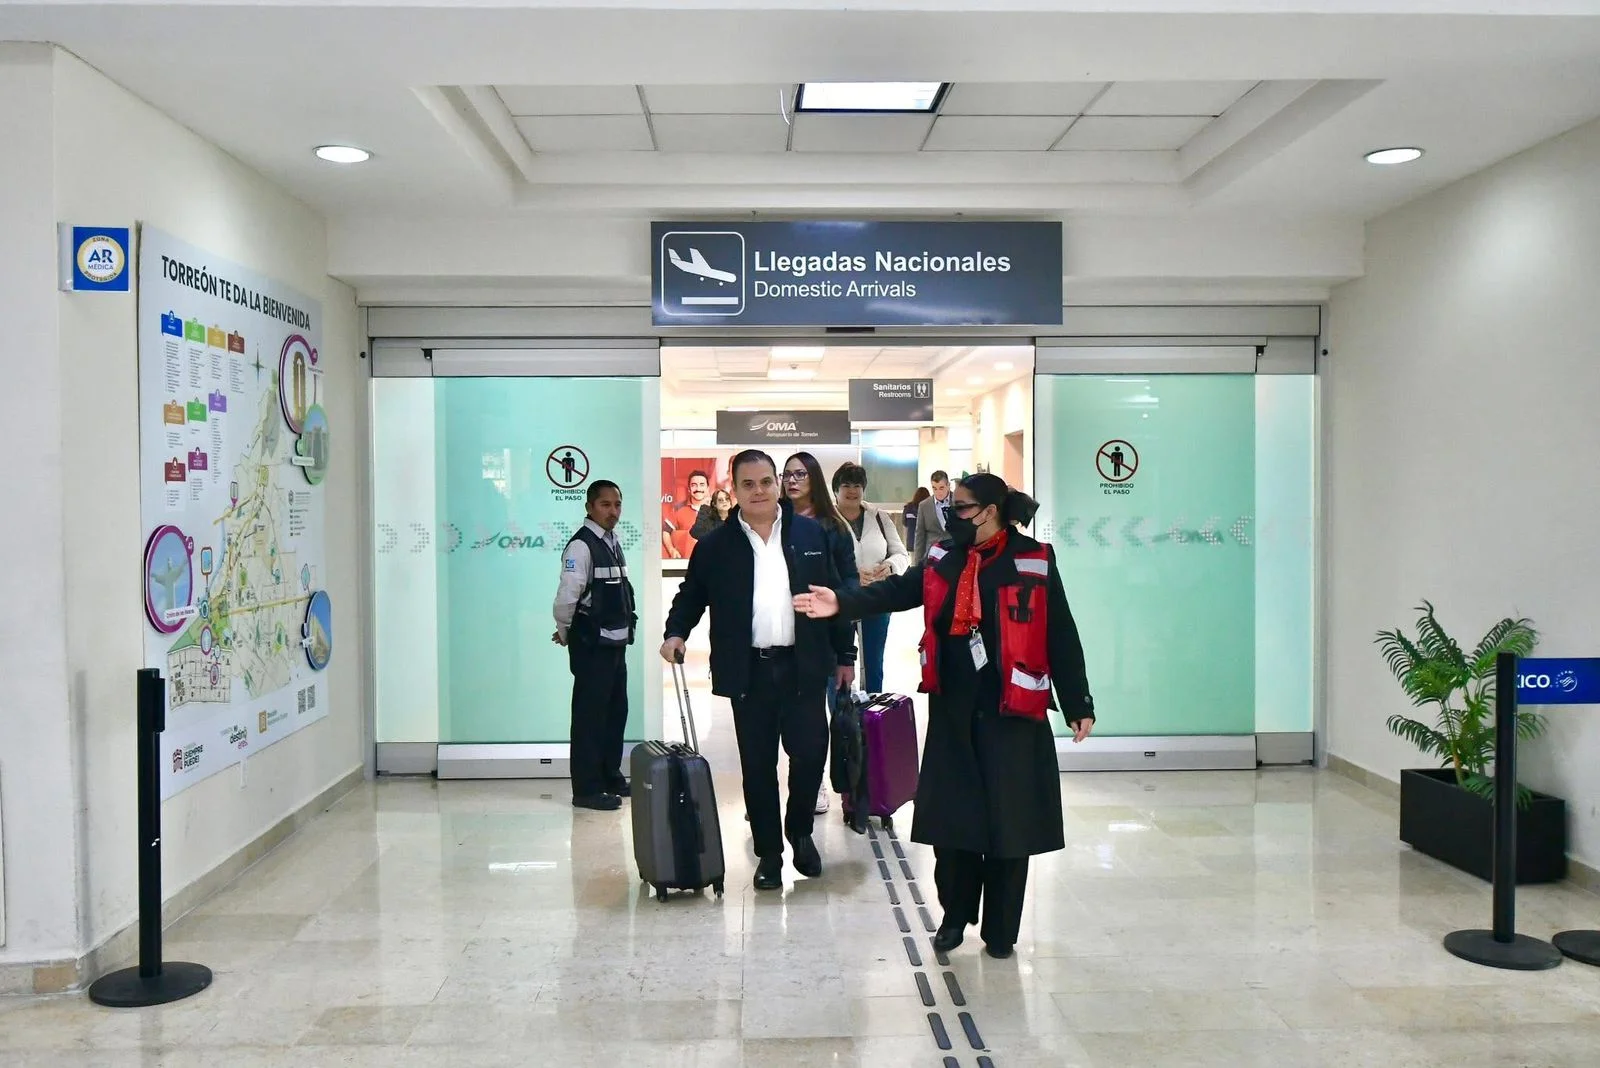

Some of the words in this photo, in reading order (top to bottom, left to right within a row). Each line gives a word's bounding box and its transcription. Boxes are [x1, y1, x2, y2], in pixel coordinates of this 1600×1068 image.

[88, 249, 113, 263] AR
[754, 251, 866, 277] Llegadas
[875, 251, 1011, 272] Nacionales
[161, 255, 217, 297] TORREÓN
[219, 278, 231, 302] TE
[233, 283, 248, 308] DA
[249, 290, 261, 313] LA
[263, 295, 311, 331] BIENVENIDA
[754, 281, 842, 297] Domestic
[846, 281, 916, 297] Arrivals
[873, 383, 911, 391] Sanitarios
[766, 422, 796, 431] OMA
